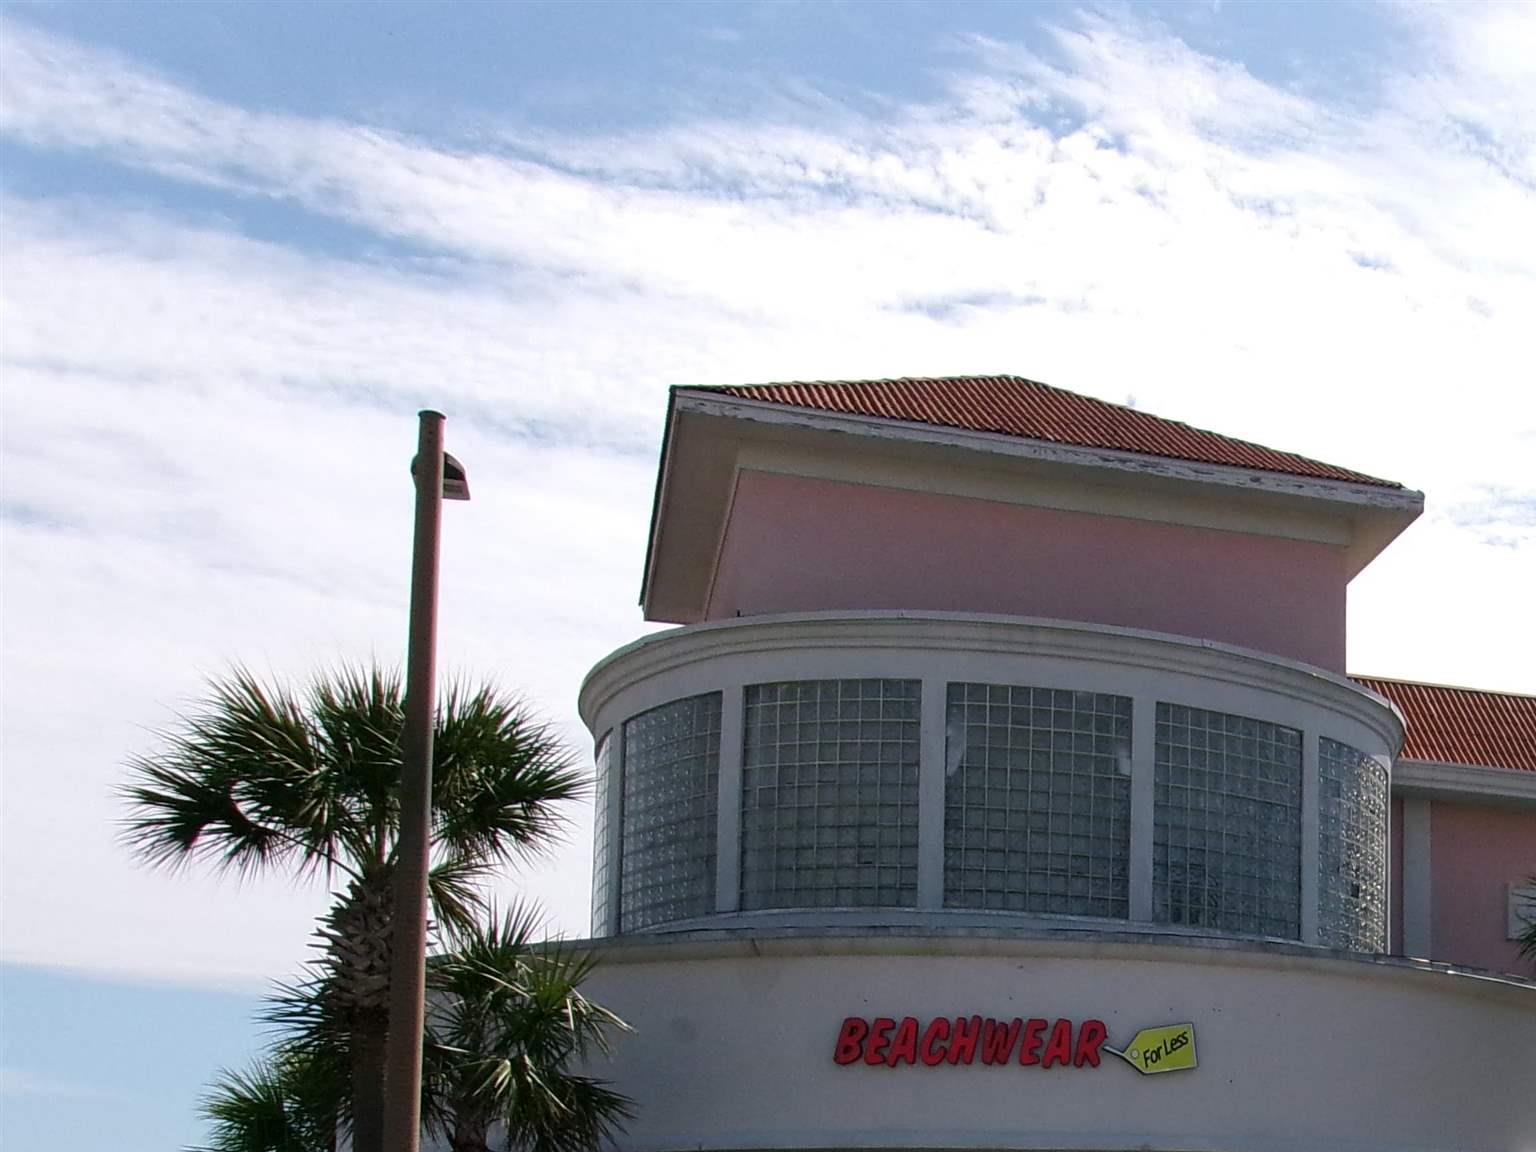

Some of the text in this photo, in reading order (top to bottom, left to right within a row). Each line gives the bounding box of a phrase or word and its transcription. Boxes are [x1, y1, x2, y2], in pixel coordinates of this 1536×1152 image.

[834, 1015, 1107, 1068] BEACHWEAR
[1143, 1031, 1189, 1068] For Less
